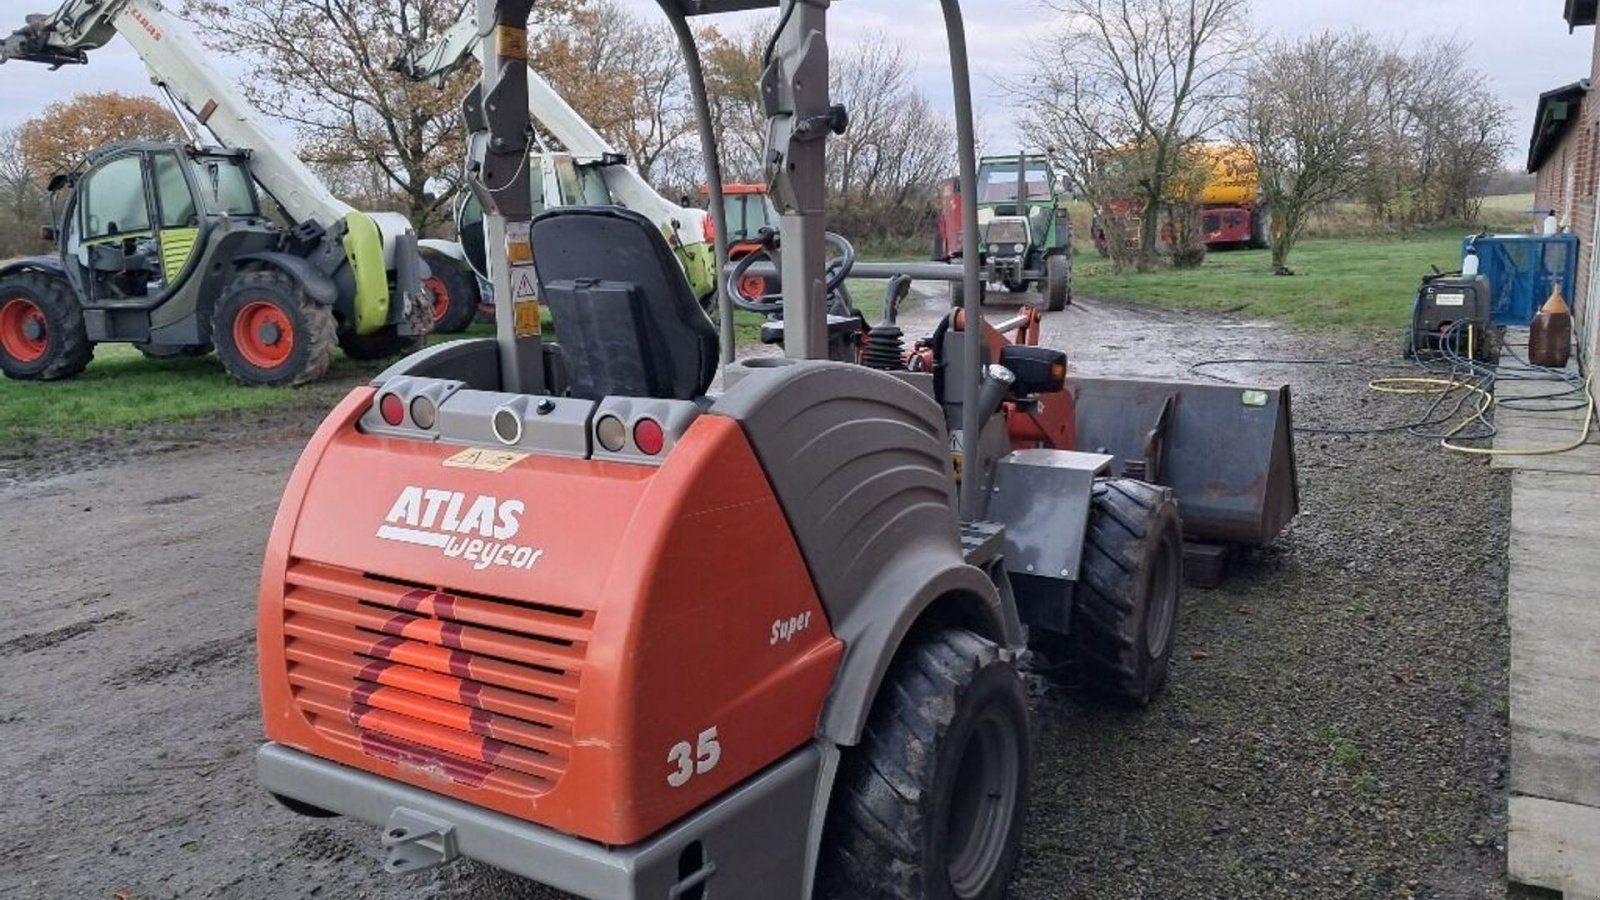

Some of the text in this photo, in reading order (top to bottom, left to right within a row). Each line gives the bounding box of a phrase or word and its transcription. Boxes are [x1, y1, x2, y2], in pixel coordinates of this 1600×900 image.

[385, 486, 525, 541] ATLAS
[770, 610, 812, 645] Super
[666, 725, 722, 787] 35
